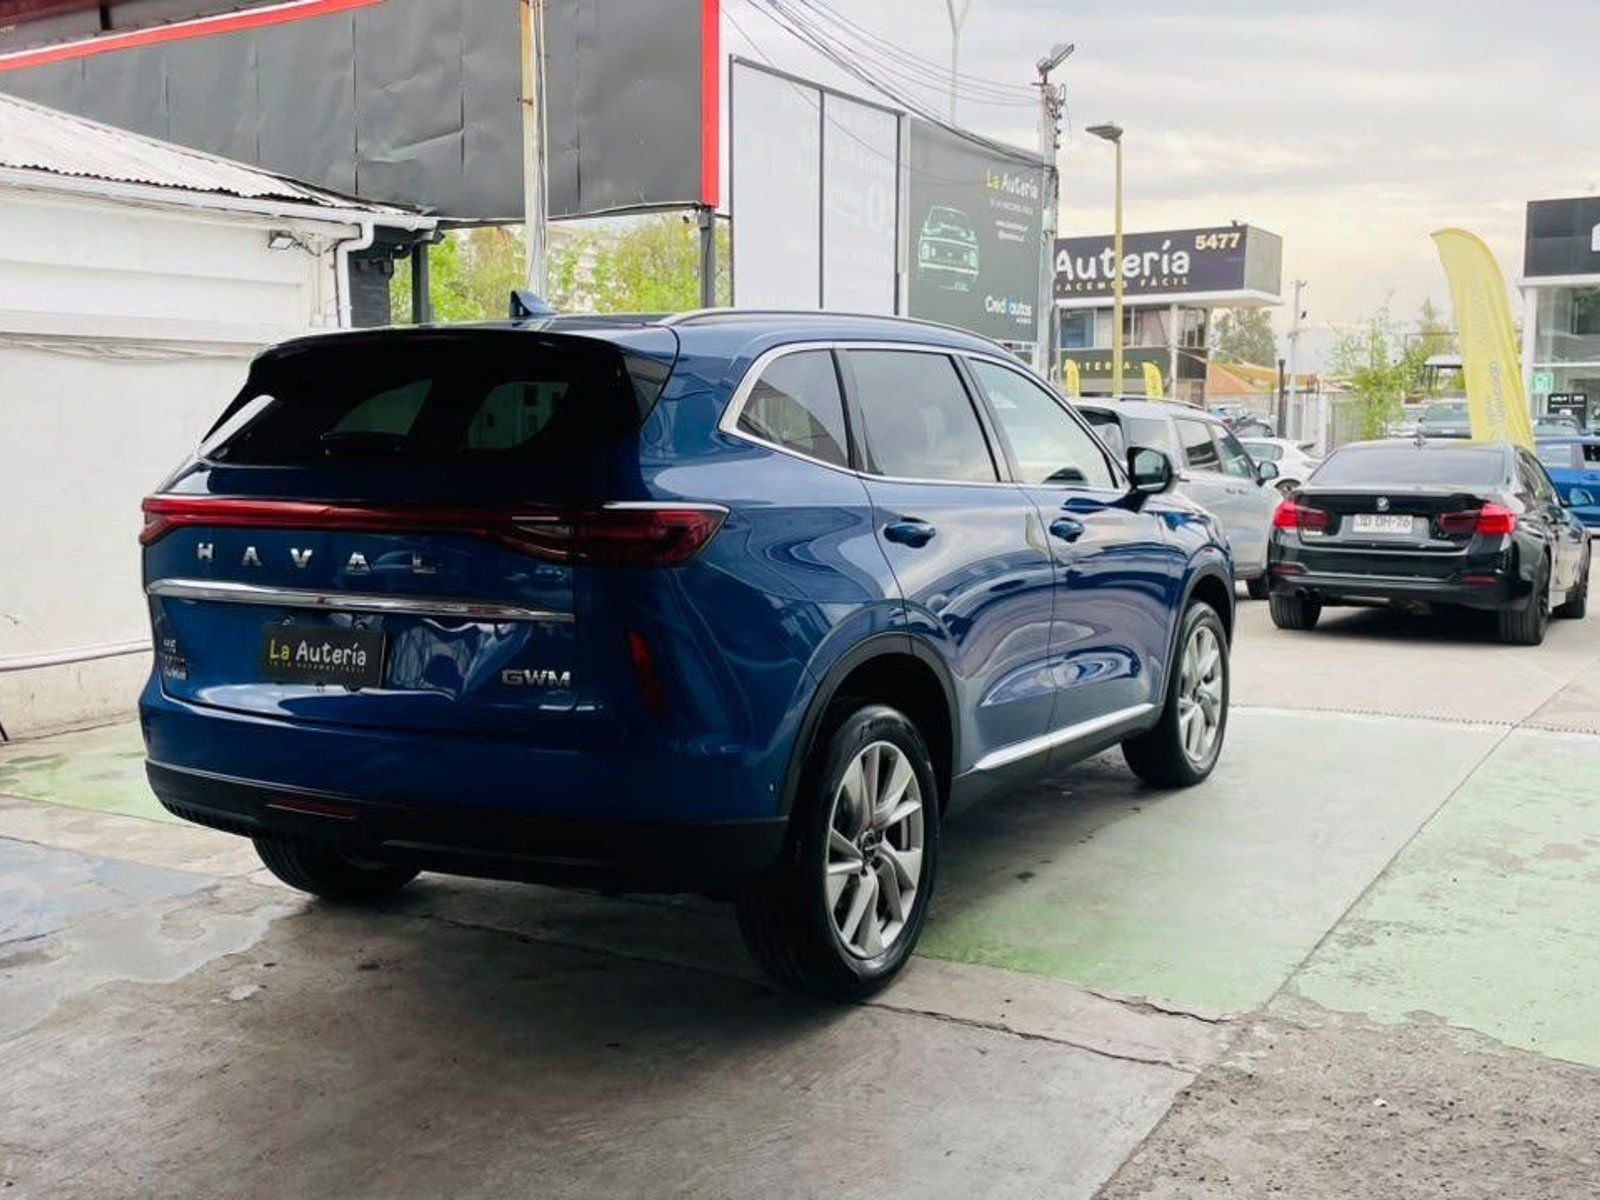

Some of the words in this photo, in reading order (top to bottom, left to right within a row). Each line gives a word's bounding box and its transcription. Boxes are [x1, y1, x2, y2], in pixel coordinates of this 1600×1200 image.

[986, 168, 1000, 190] La
[1194, 232, 1241, 250] 5477
[1055, 239, 1191, 282] Autería
[196, 542, 437, 575] HAVAL
[270, 639, 291, 660] La
[295, 641, 367, 667] Autería
[501, 668, 571, 687] GWM
